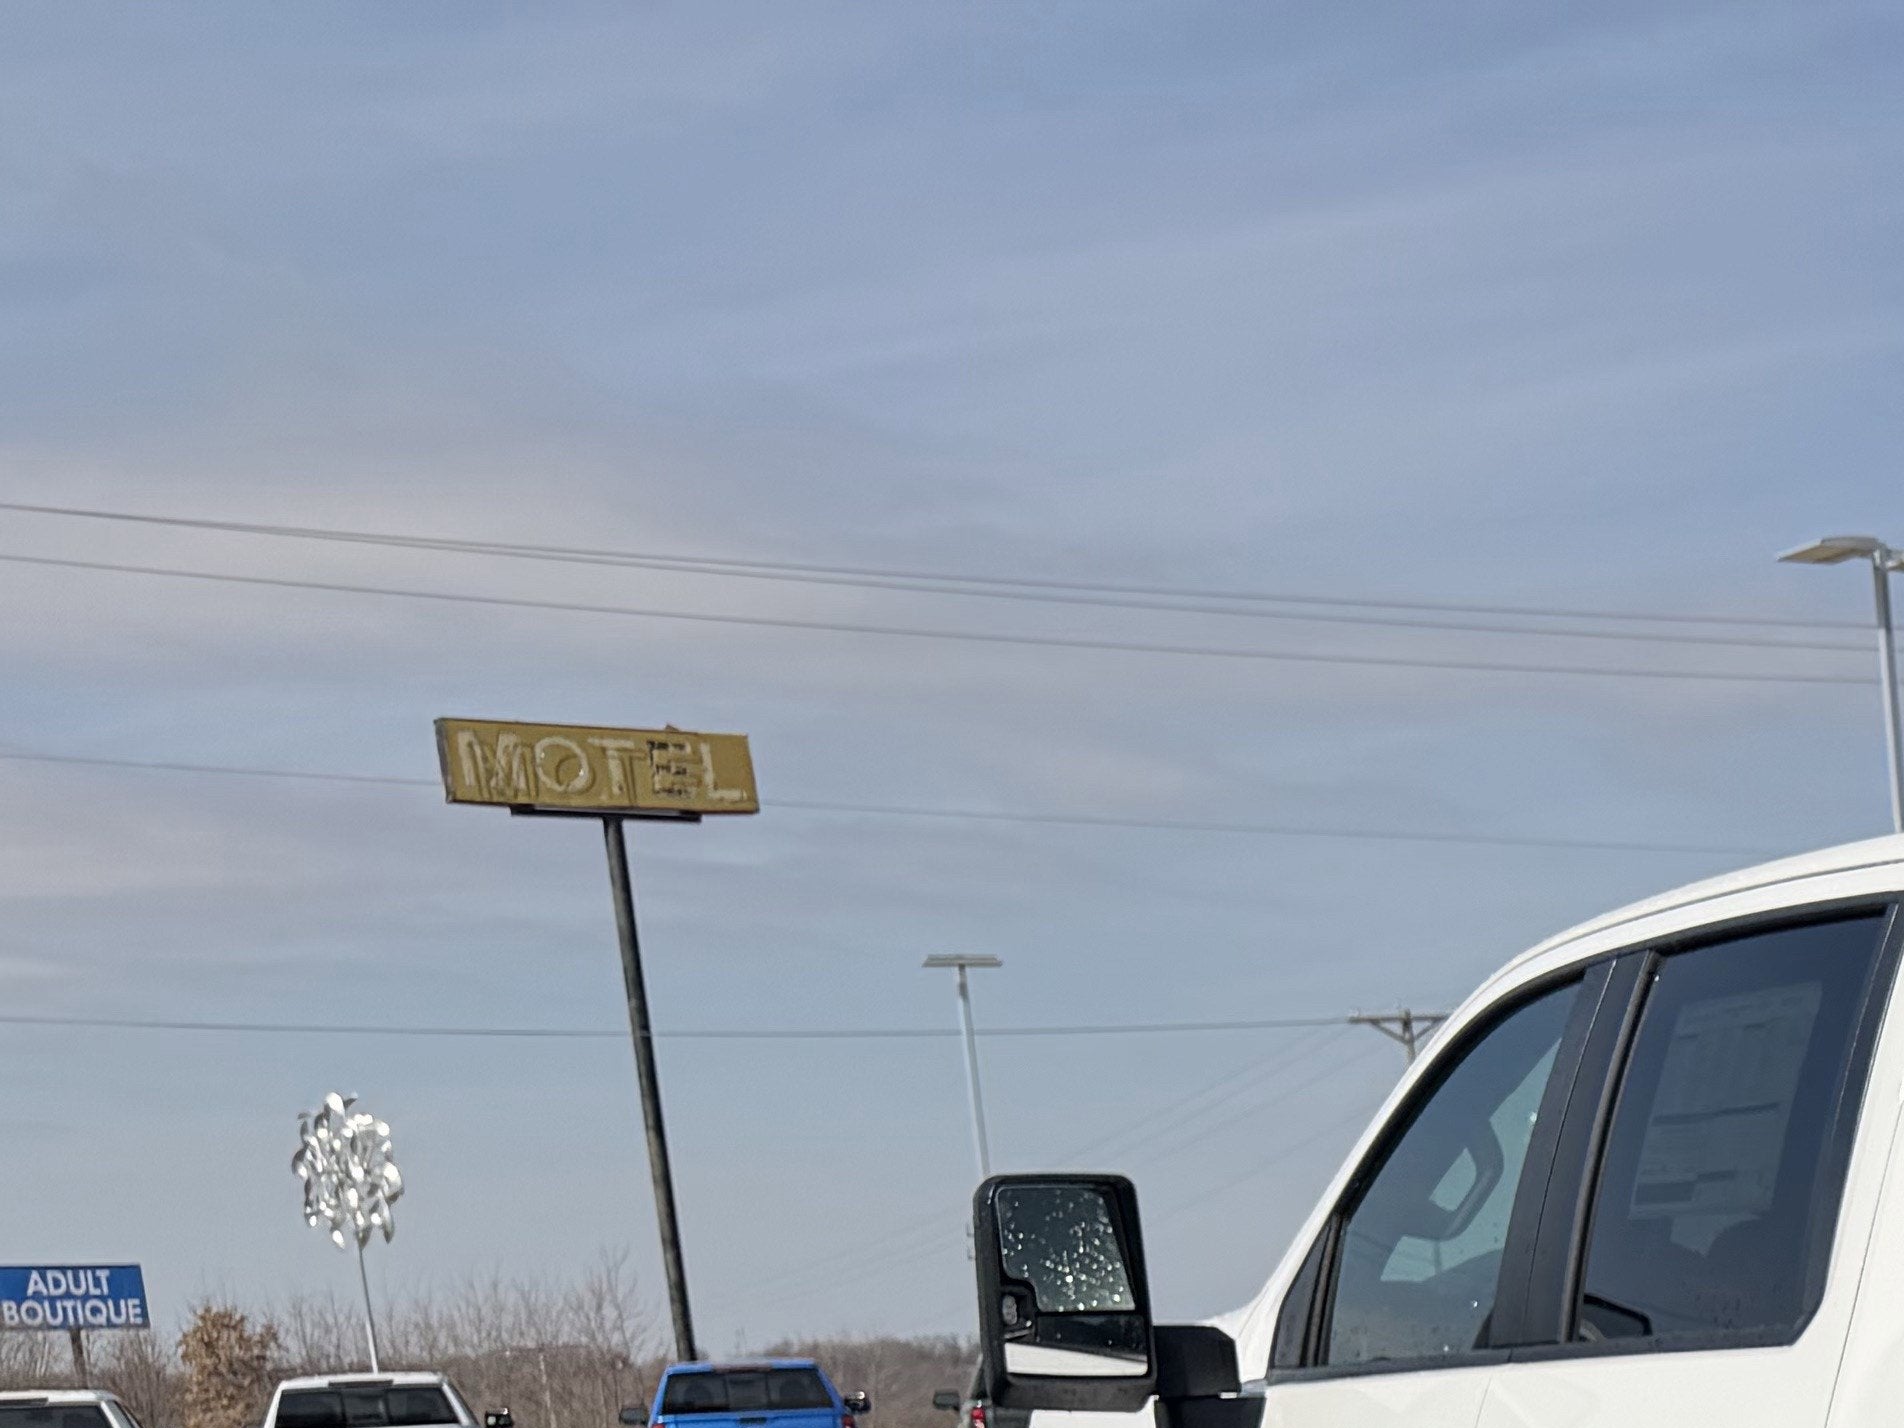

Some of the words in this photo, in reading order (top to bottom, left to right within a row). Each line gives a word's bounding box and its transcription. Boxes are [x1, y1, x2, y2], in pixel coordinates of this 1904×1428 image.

[456, 729, 748, 801] MOTEL
[27, 1269, 110, 1296] ADULT
[2, 1298, 143, 1326] BOUTIQUE
